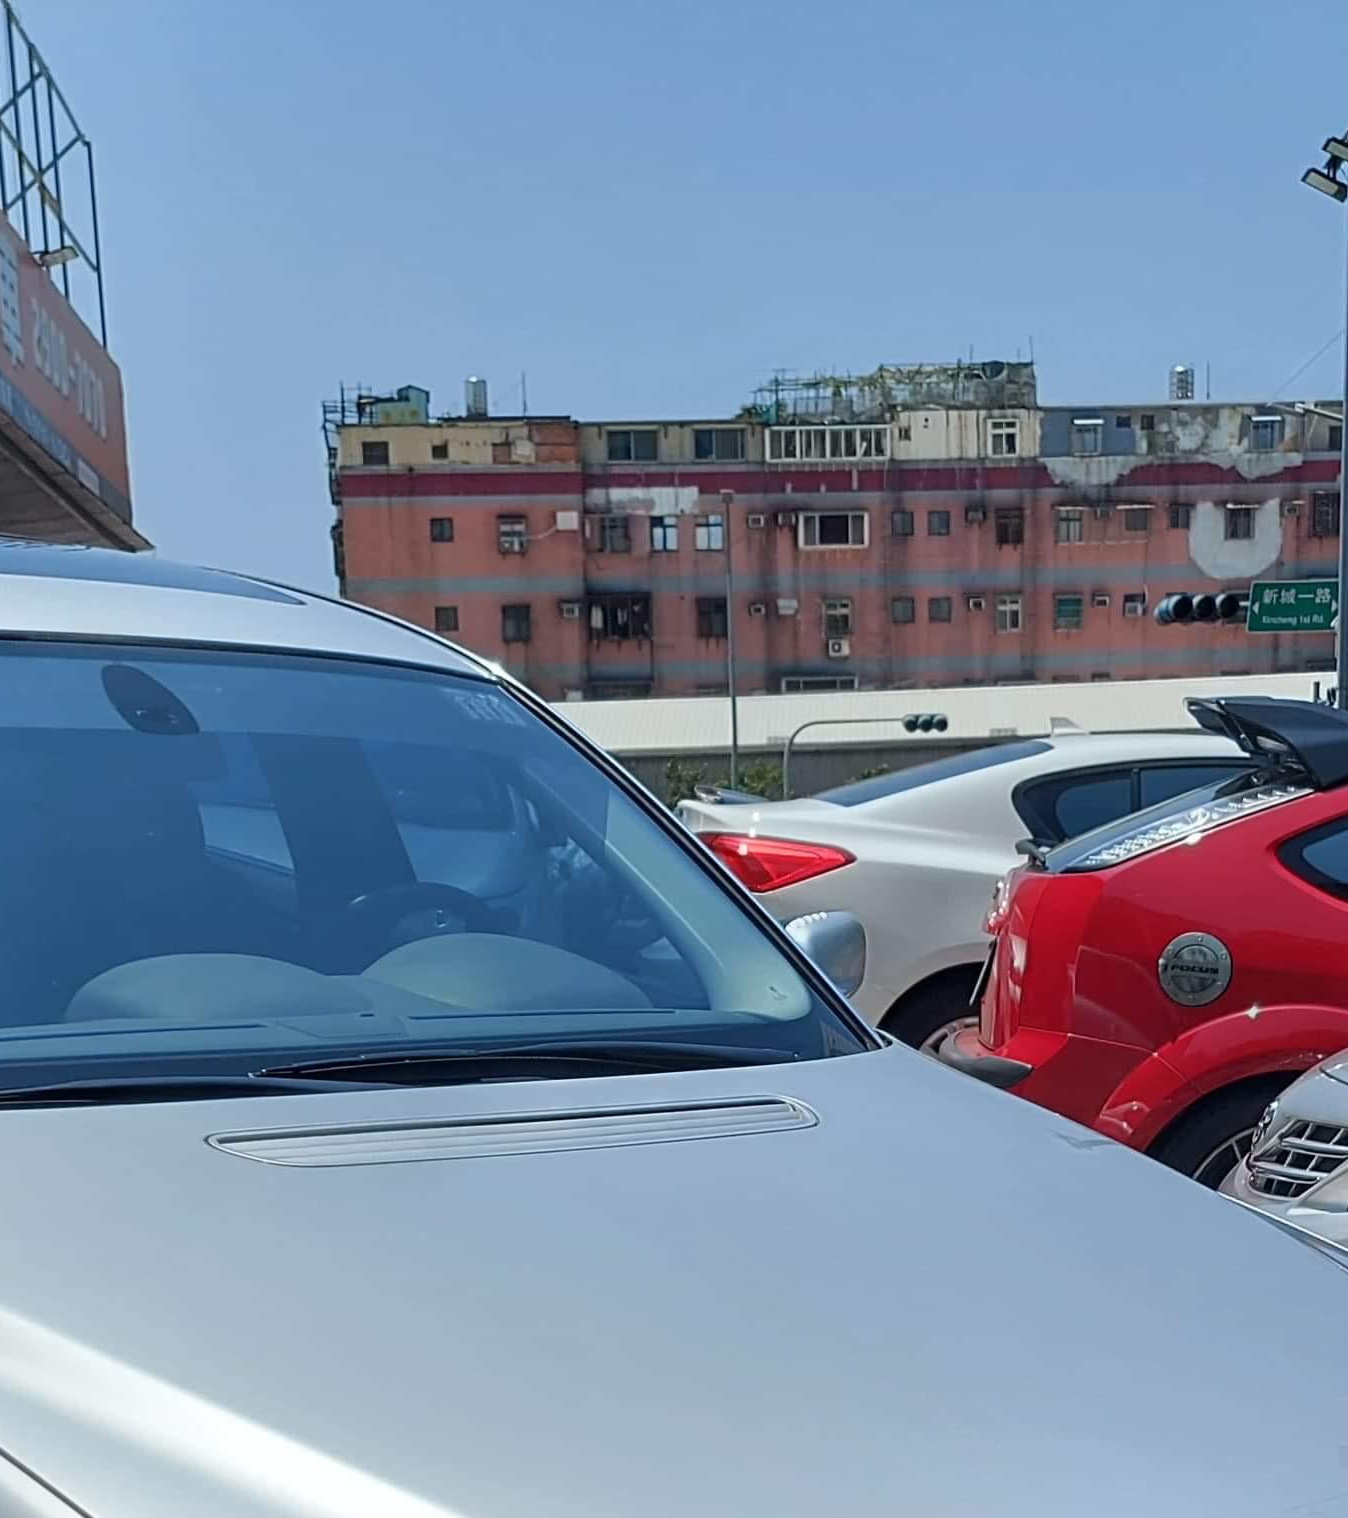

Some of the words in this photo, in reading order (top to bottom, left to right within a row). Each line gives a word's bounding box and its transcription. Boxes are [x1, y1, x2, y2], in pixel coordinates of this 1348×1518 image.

[1262, 587, 1332, 605] 新城一路
[1171, 964, 1219, 975] FOCUS
